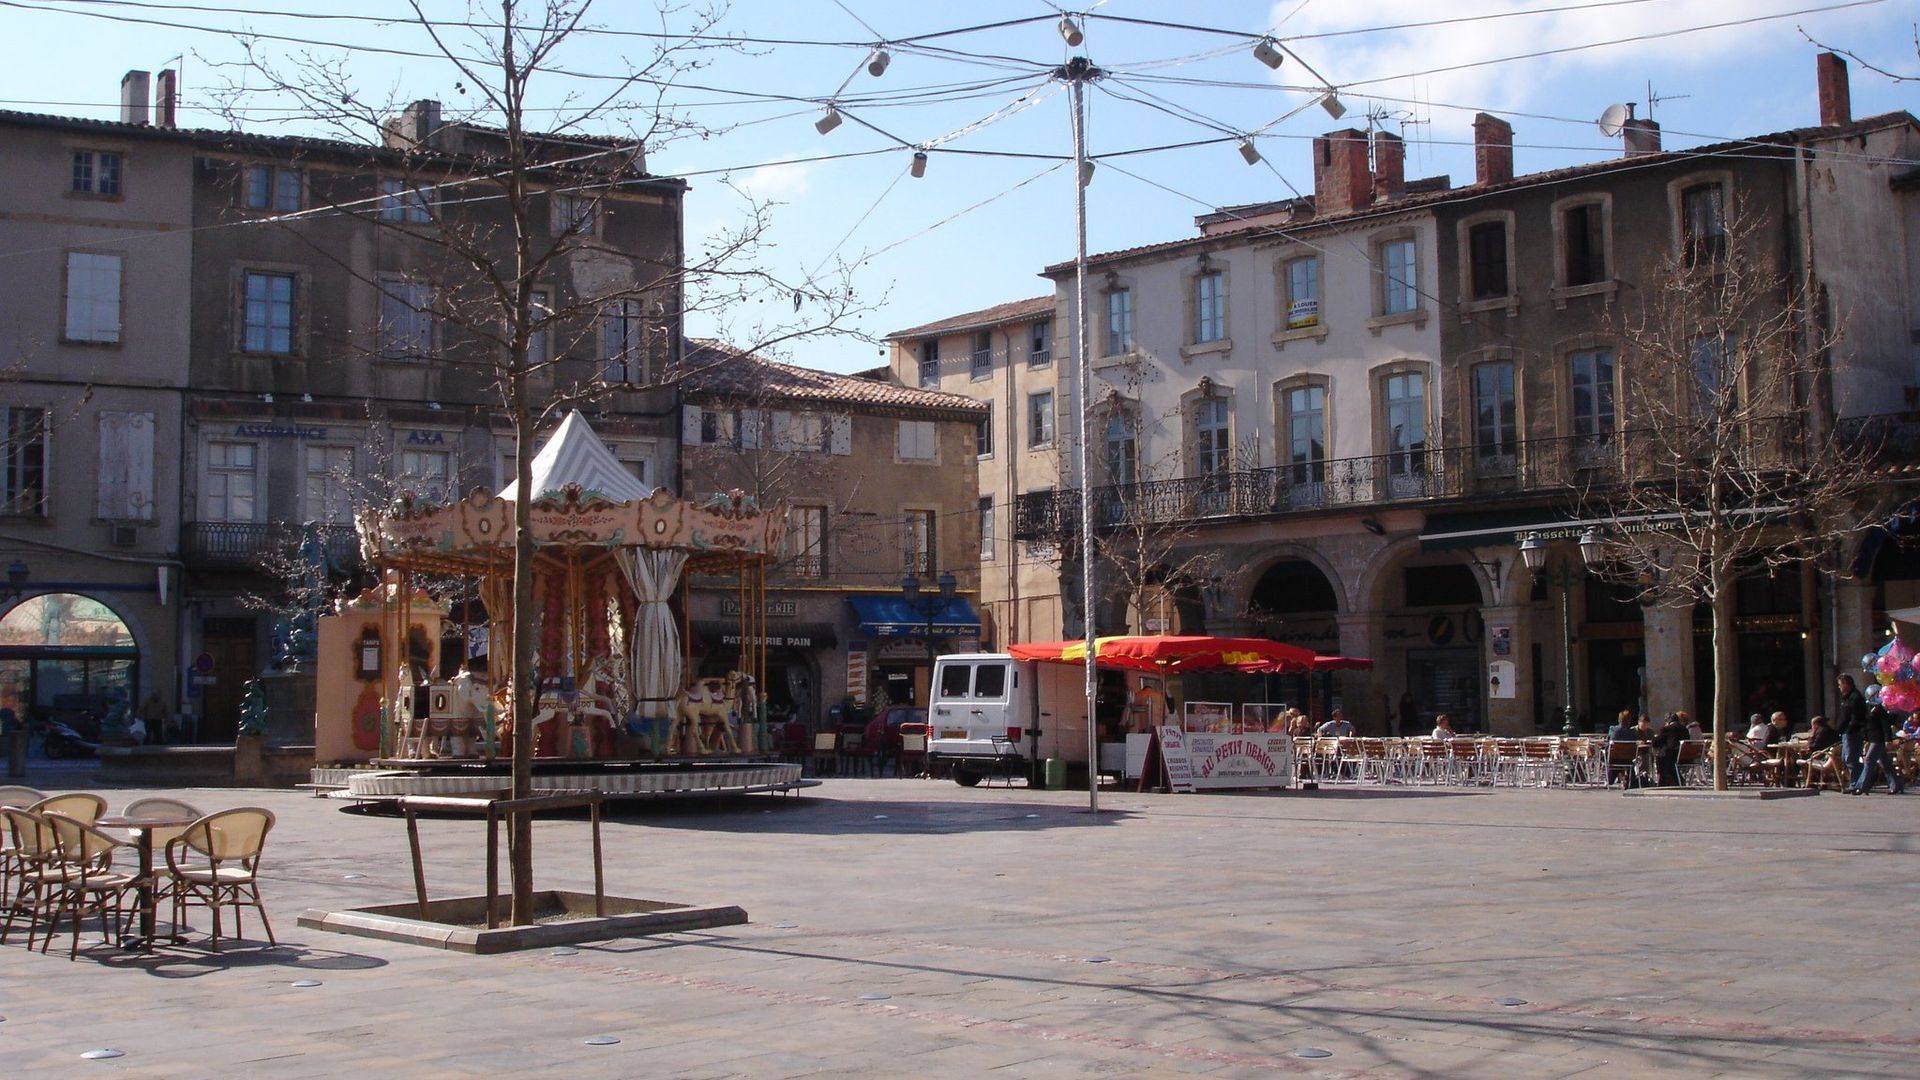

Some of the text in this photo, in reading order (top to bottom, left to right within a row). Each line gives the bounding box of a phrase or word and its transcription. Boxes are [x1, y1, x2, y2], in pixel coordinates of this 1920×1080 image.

[407, 431, 444, 445] AXA
[1515, 529, 1583, 541] Bsserie
[726, 602, 795, 613] PERIE
[722, 636, 811, 646] PATSSRIE PAIN
[1201, 756, 1215, 778] AU
[1215, 740, 1243, 762] PETIT
